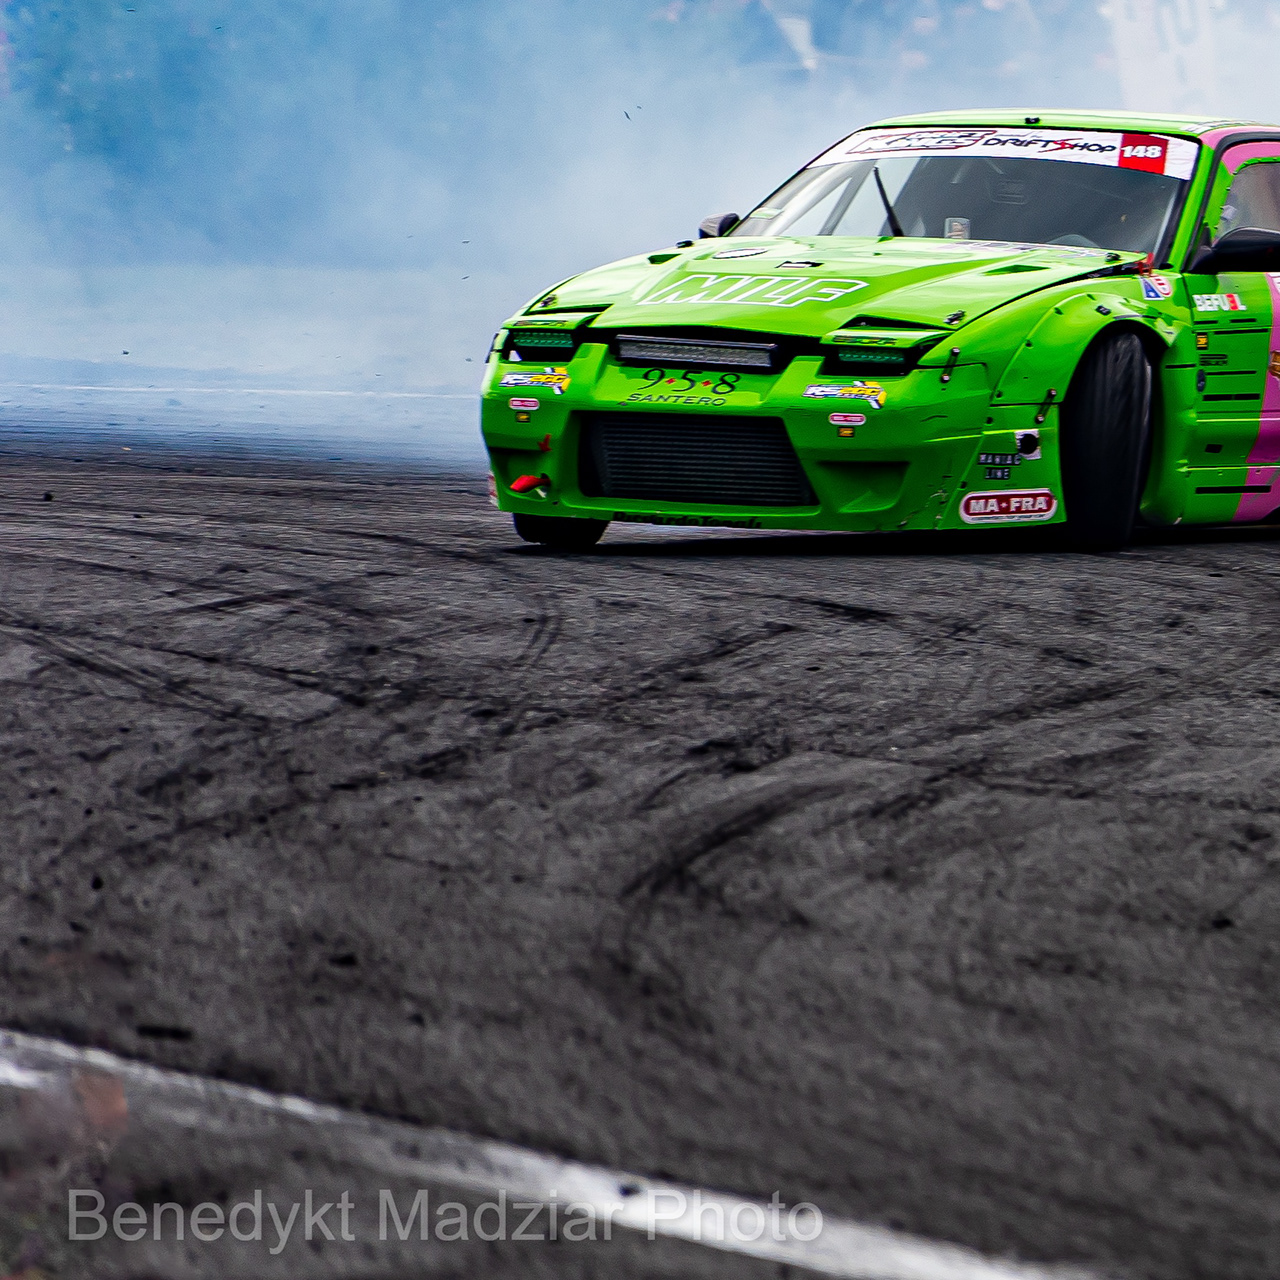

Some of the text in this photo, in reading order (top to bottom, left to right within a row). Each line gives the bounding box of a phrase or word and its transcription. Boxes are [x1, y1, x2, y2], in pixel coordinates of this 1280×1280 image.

[1121, 145, 1163, 159] 148
[1192, 293, 1247, 311] BEFUEL
[627, 392, 726, 407] SANTERO
